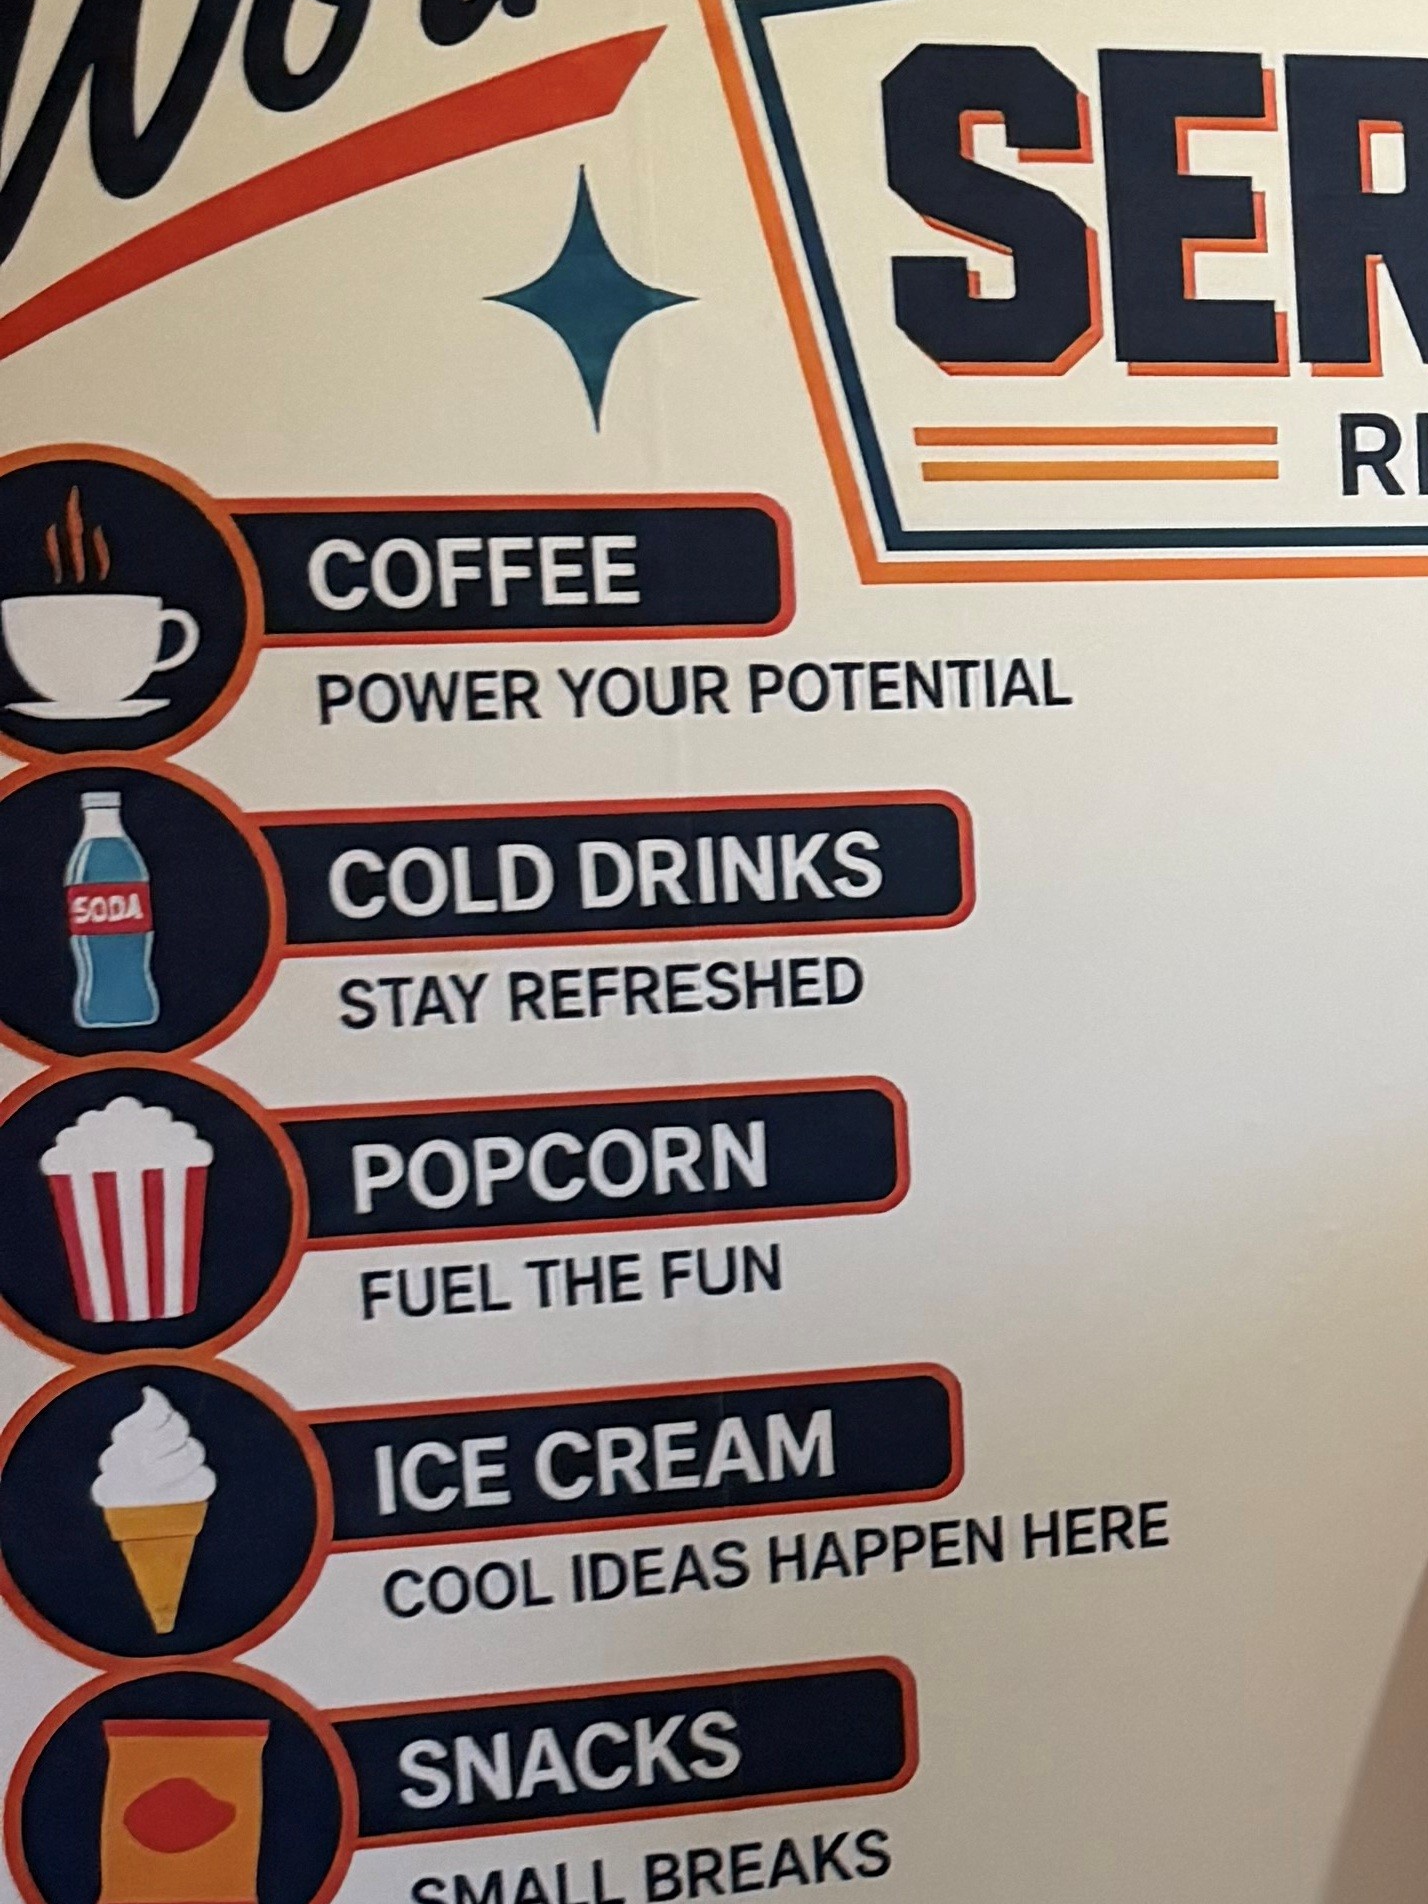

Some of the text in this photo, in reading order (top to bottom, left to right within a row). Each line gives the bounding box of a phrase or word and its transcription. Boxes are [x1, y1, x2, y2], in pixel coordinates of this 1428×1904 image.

[307, 535, 640, 611] COFFEE
[317, 658, 1073, 725] POWER YOUR POTENTIAL
[71, 893, 144, 924] SODA
[327, 830, 884, 919] COLD DRINKS
[339, 956, 865, 1030] STAY REFRESHED
[352, 1120, 768, 1215] POPCORN
[360, 1243, 783, 1320] FUEL THE FUN
[374, 1408, 836, 1516] ICE CREAM
[383, 1500, 1170, 1619] COOL IDEAS HAPPEN HERE
[398, 1710, 743, 1810] SNACKS
[644, 1828, 892, 1903] BREAKS
